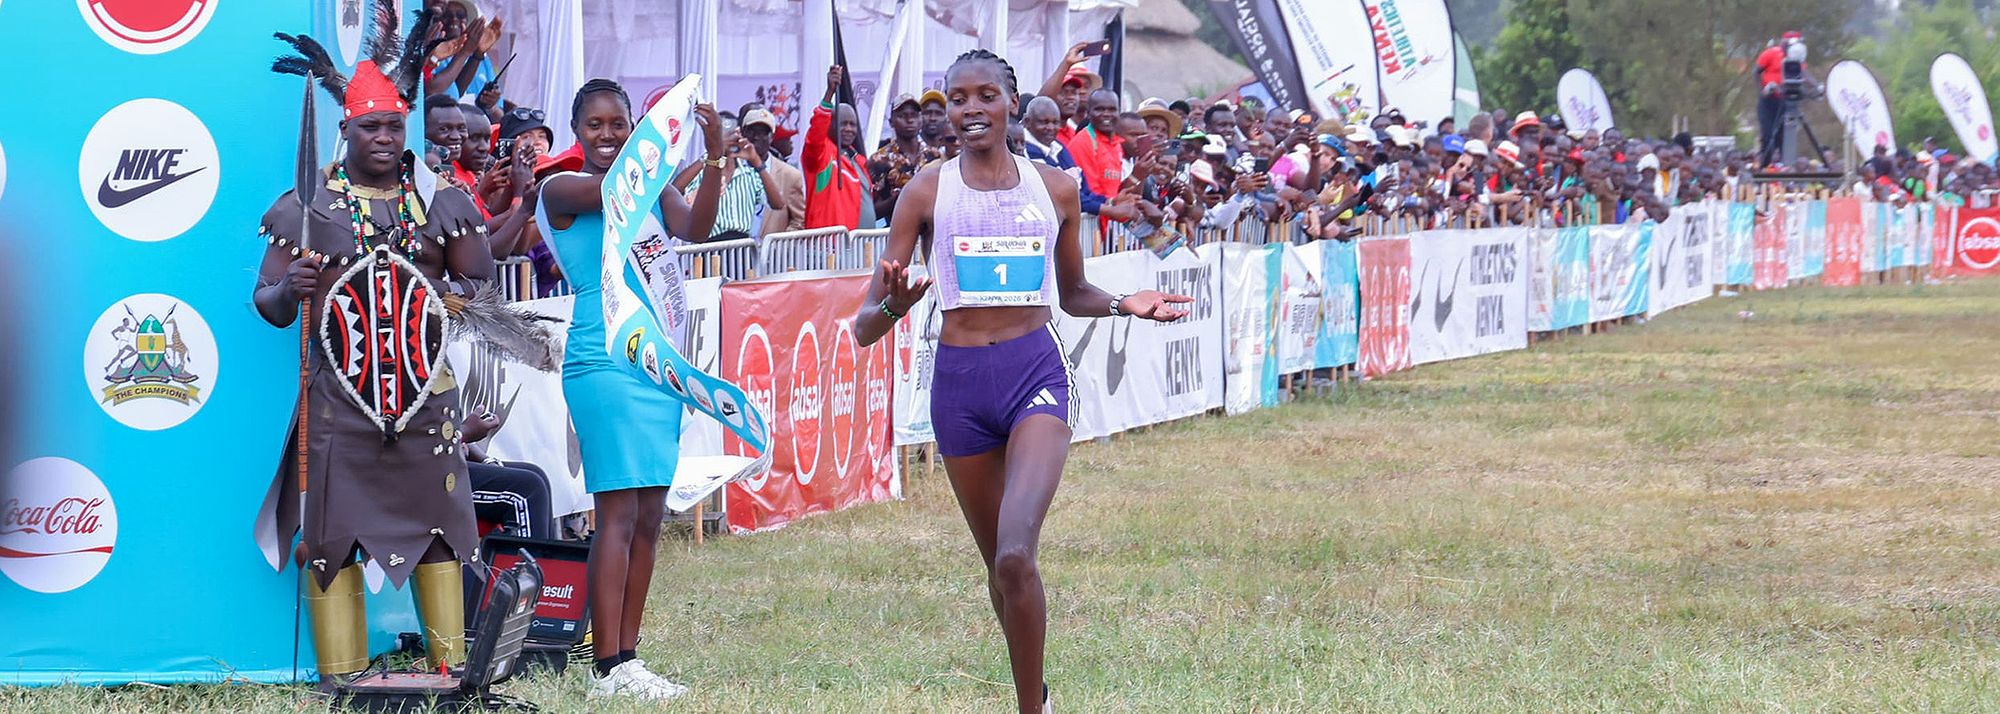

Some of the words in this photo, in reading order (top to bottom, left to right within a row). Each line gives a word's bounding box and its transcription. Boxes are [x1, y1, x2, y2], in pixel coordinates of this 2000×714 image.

[112, 149, 184, 180] NIKE
[660, 262, 684, 328] SIRIKWA
[993, 263, 1007, 286] 1
[834, 367, 853, 417] absa
[1165, 336, 1203, 398] KENYA
[114, 390, 133, 401] THE
[134, 387, 188, 401] CHAMPIONS
[747, 374, 771, 424] bsa
[793, 370, 818, 421] absa
[541, 584, 573, 599] esult
